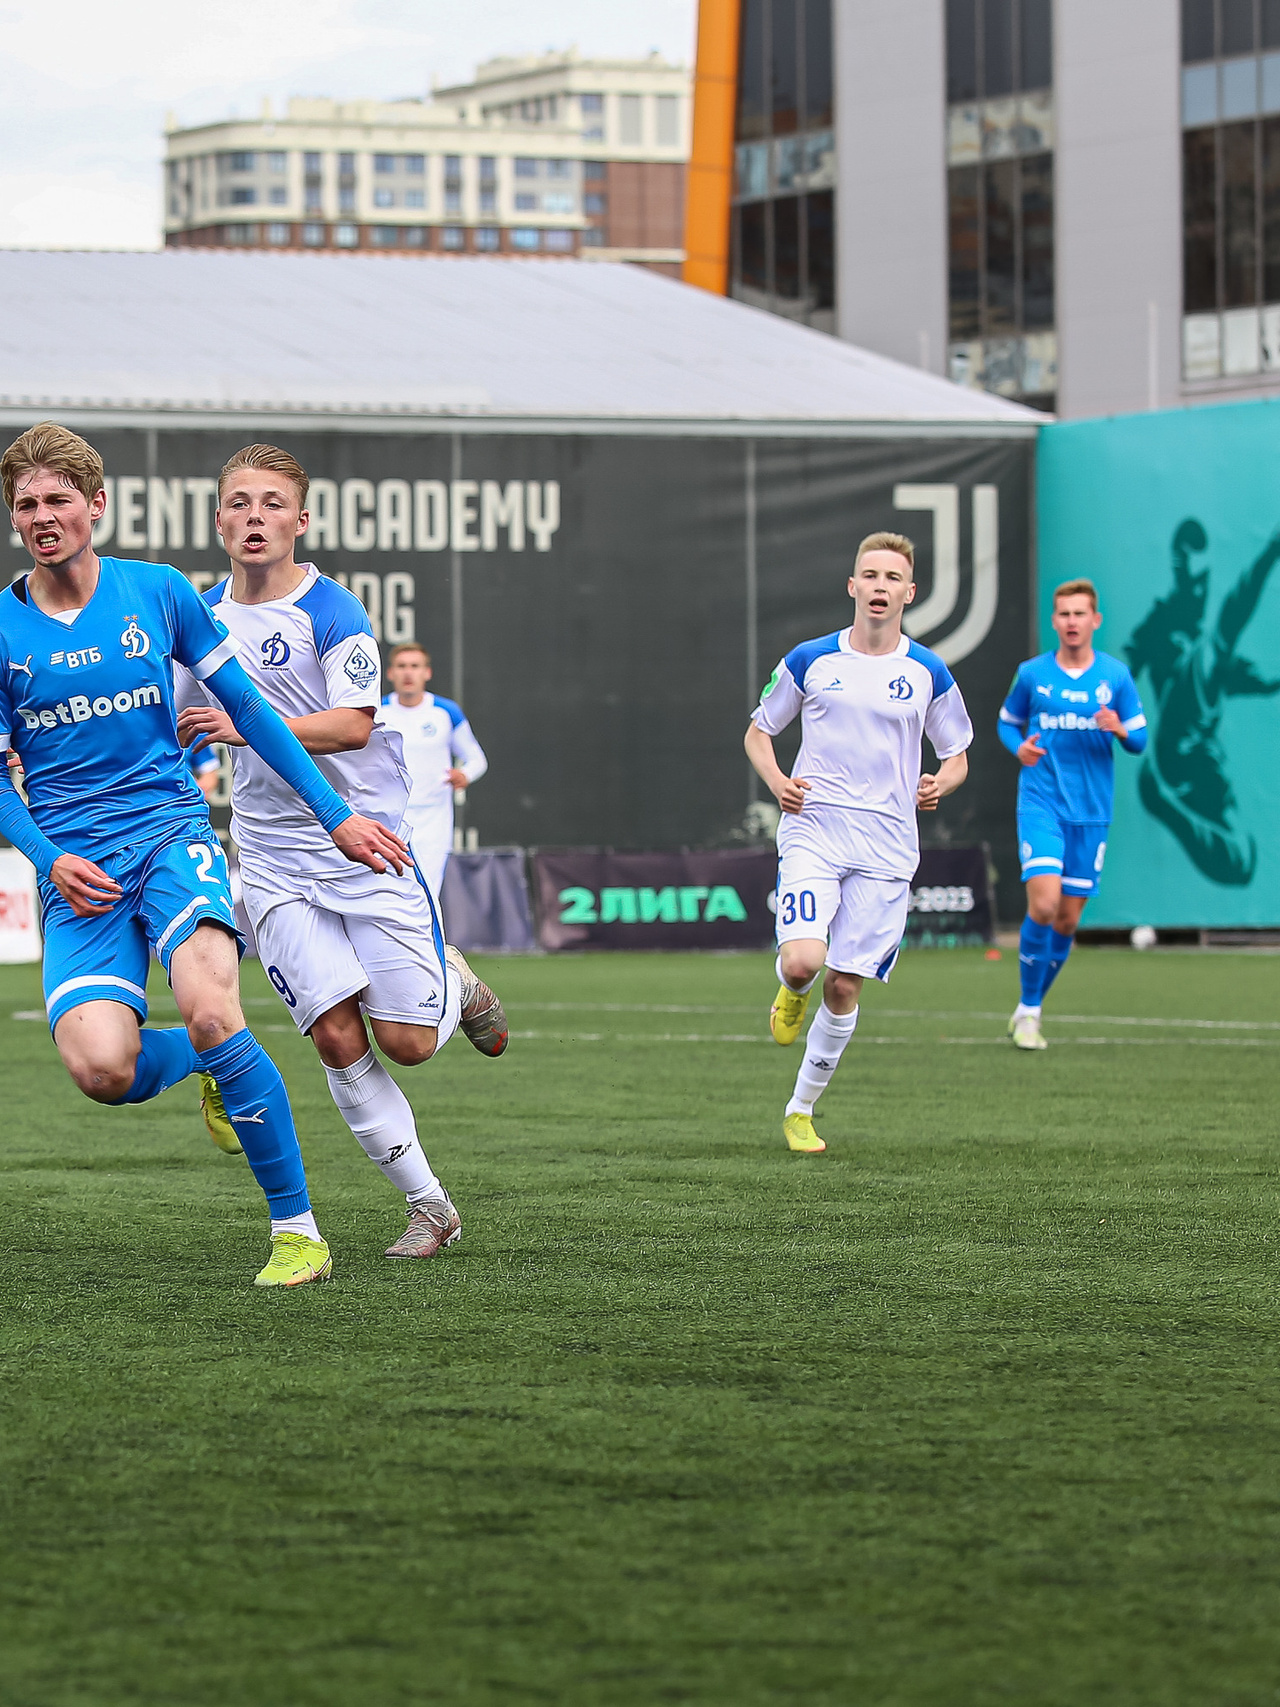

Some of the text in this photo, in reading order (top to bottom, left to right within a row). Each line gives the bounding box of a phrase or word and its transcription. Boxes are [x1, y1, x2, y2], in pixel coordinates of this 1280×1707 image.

[303, 477, 561, 553] ACADEMY
[66, 647, 102, 669] ВТБ
[17, 685, 161, 730] BetBoom
[1039, 711, 1098, 730] BetBoo
[782, 890, 817, 926] 30
[267, 964, 297, 1009] 9
